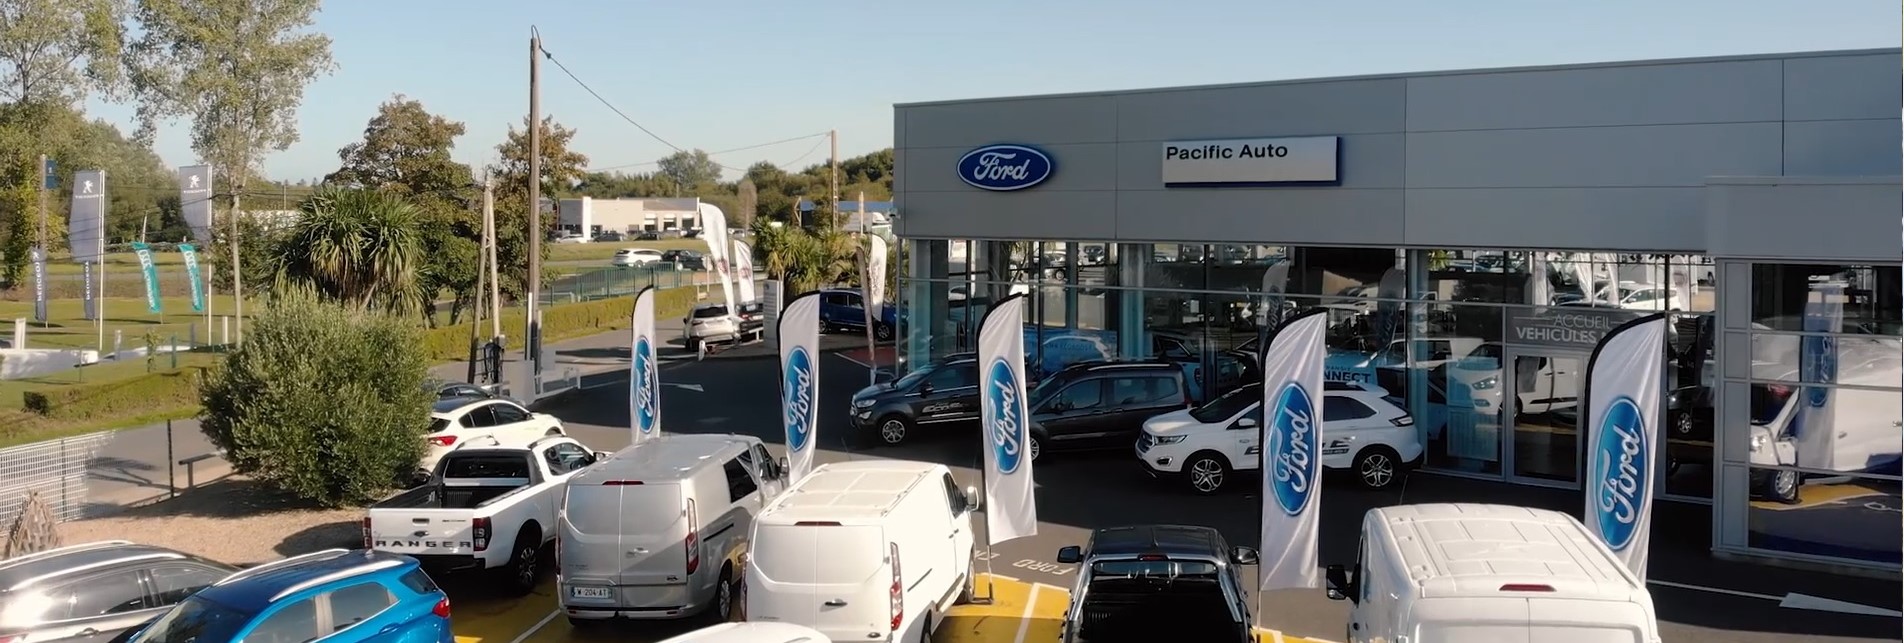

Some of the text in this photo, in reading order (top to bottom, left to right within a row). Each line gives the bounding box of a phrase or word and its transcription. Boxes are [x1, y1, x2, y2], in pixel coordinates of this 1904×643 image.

[974, 152, 1031, 181] Ford
[1166, 143, 1289, 161] Pacific Auto
[1516, 326, 1597, 344] VEHICULES
[1553, 314, 1611, 330] ACCUEIL
[636, 353, 654, 418] Ford
[787, 364, 811, 434] Ford
[988, 380, 1020, 456] Ford
[1273, 406, 1310, 493] Ford
[1600, 424, 1641, 524] Ford
[1012, 559, 1075, 576] FORD
